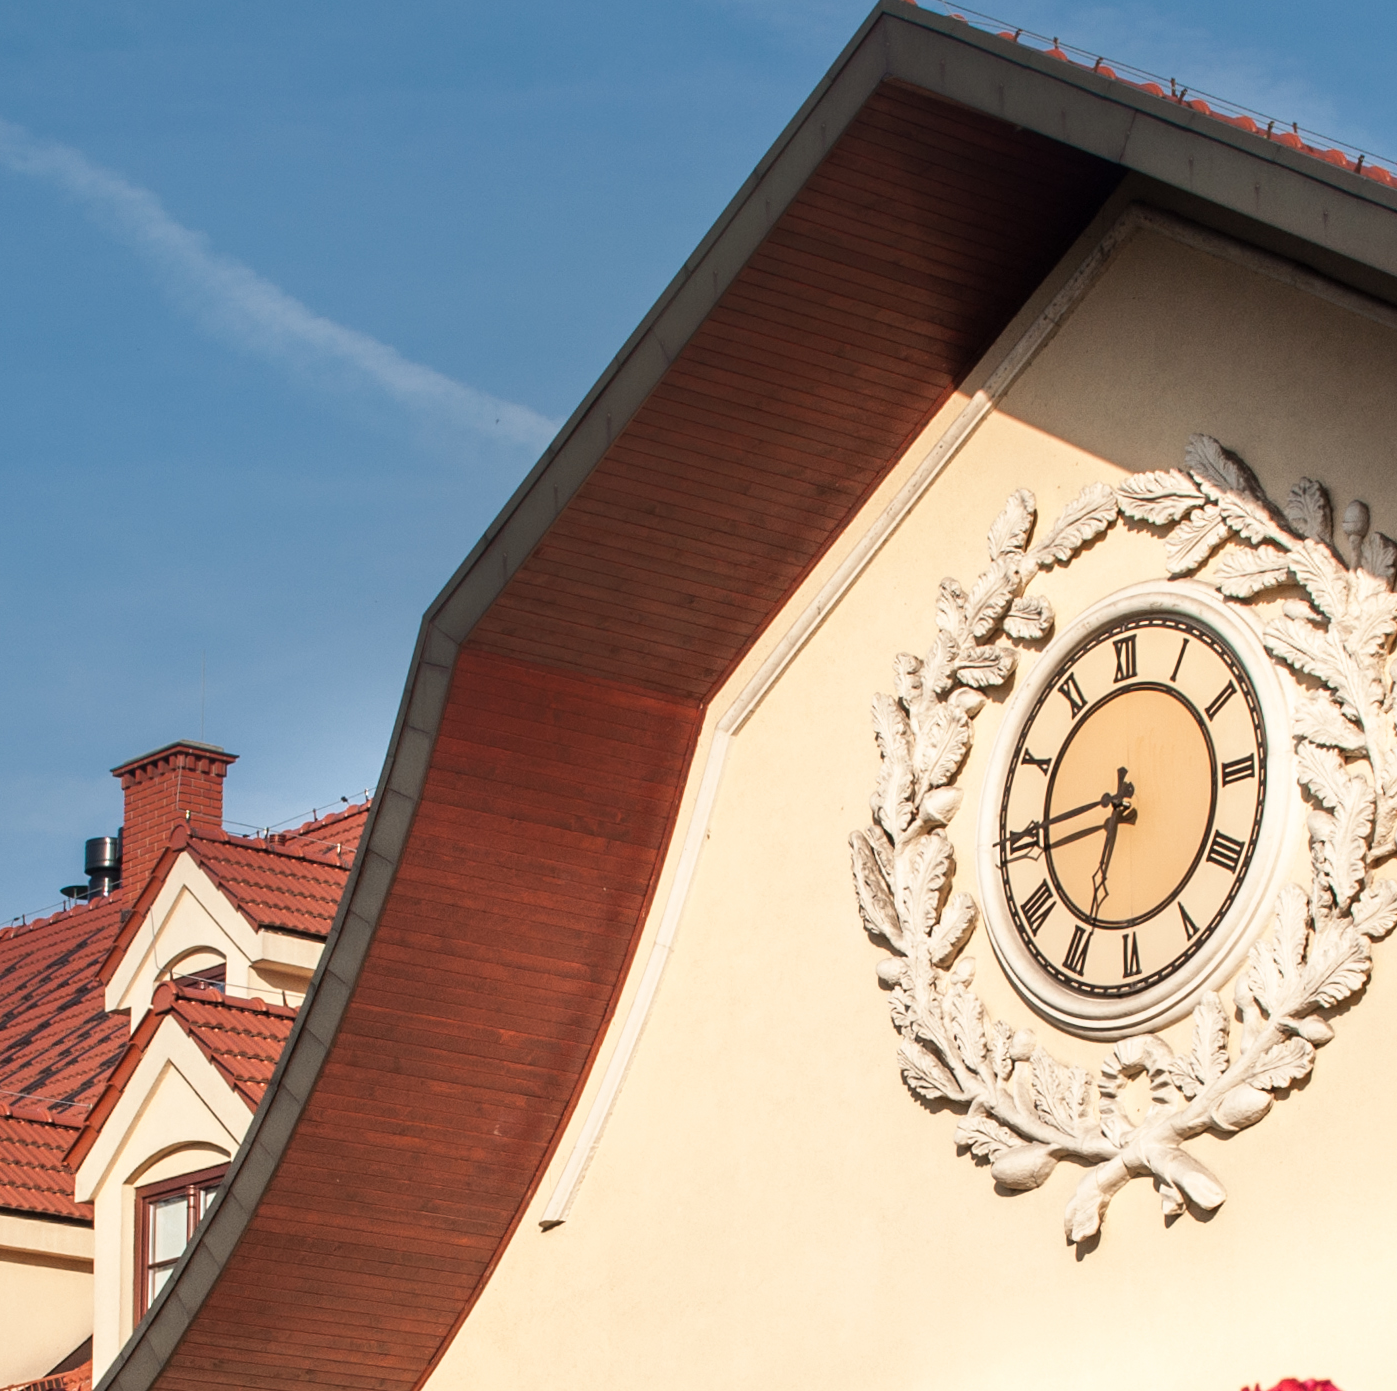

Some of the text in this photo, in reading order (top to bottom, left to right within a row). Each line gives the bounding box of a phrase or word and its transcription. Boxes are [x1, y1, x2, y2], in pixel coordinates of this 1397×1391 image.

[1113, 634, 1137, 683] XII
[1171, 638, 1189, 682] I
[1057, 672, 1088, 719] XI
[1205, 680, 1237, 721] II
[1022, 748, 1052, 776] X
[1222, 753, 1255, 787] III
[1178, 901, 1199, 941] V
[1062, 924, 1093, 976] VII
[1123, 932, 1142, 979] VI
